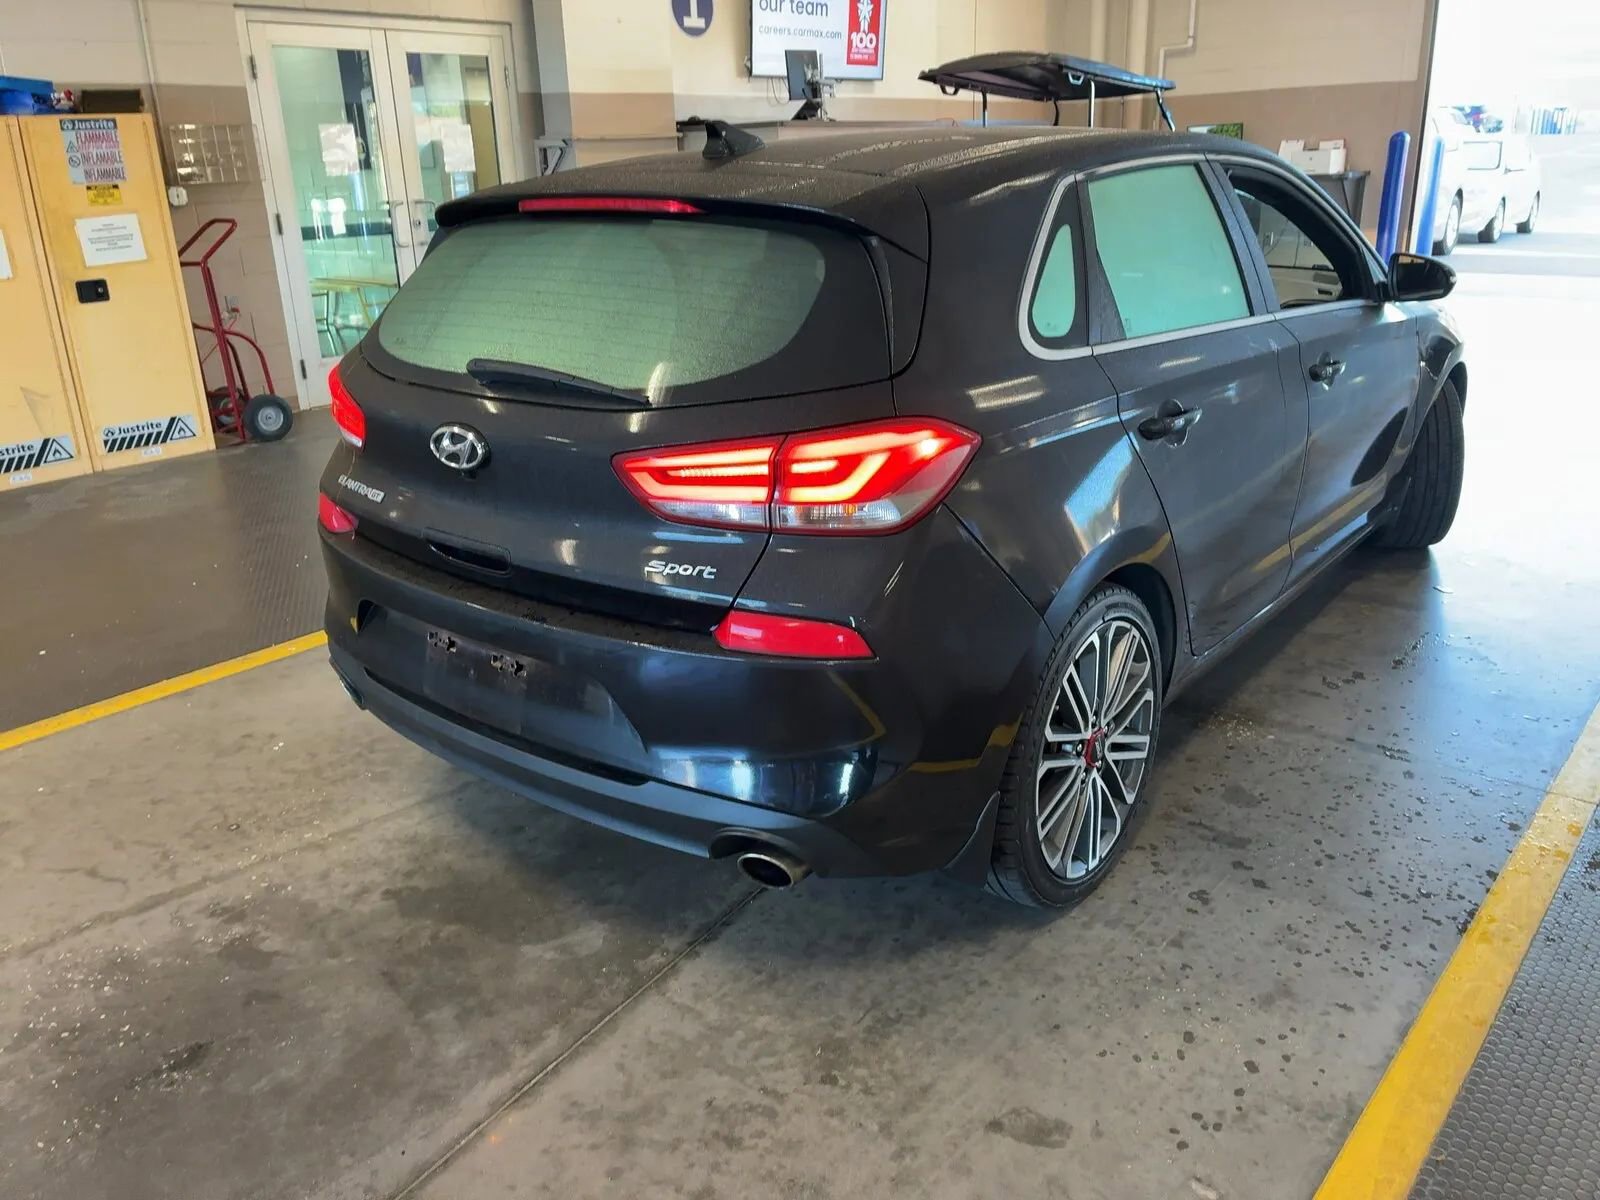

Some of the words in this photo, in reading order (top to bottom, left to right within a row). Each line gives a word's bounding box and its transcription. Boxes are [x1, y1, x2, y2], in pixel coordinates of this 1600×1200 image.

[759, 0, 786, 12] our
[789, 0, 829, 17] team
[758, 25, 842, 40] careers.carmax.com
[850, 31, 877, 49] 100
[74, 120, 114, 129] Justrite
[75, 130, 120, 145] FLAMMABLE
[117, 421, 162, 435] Justrite
[644, 560, 717, 579] Sport
